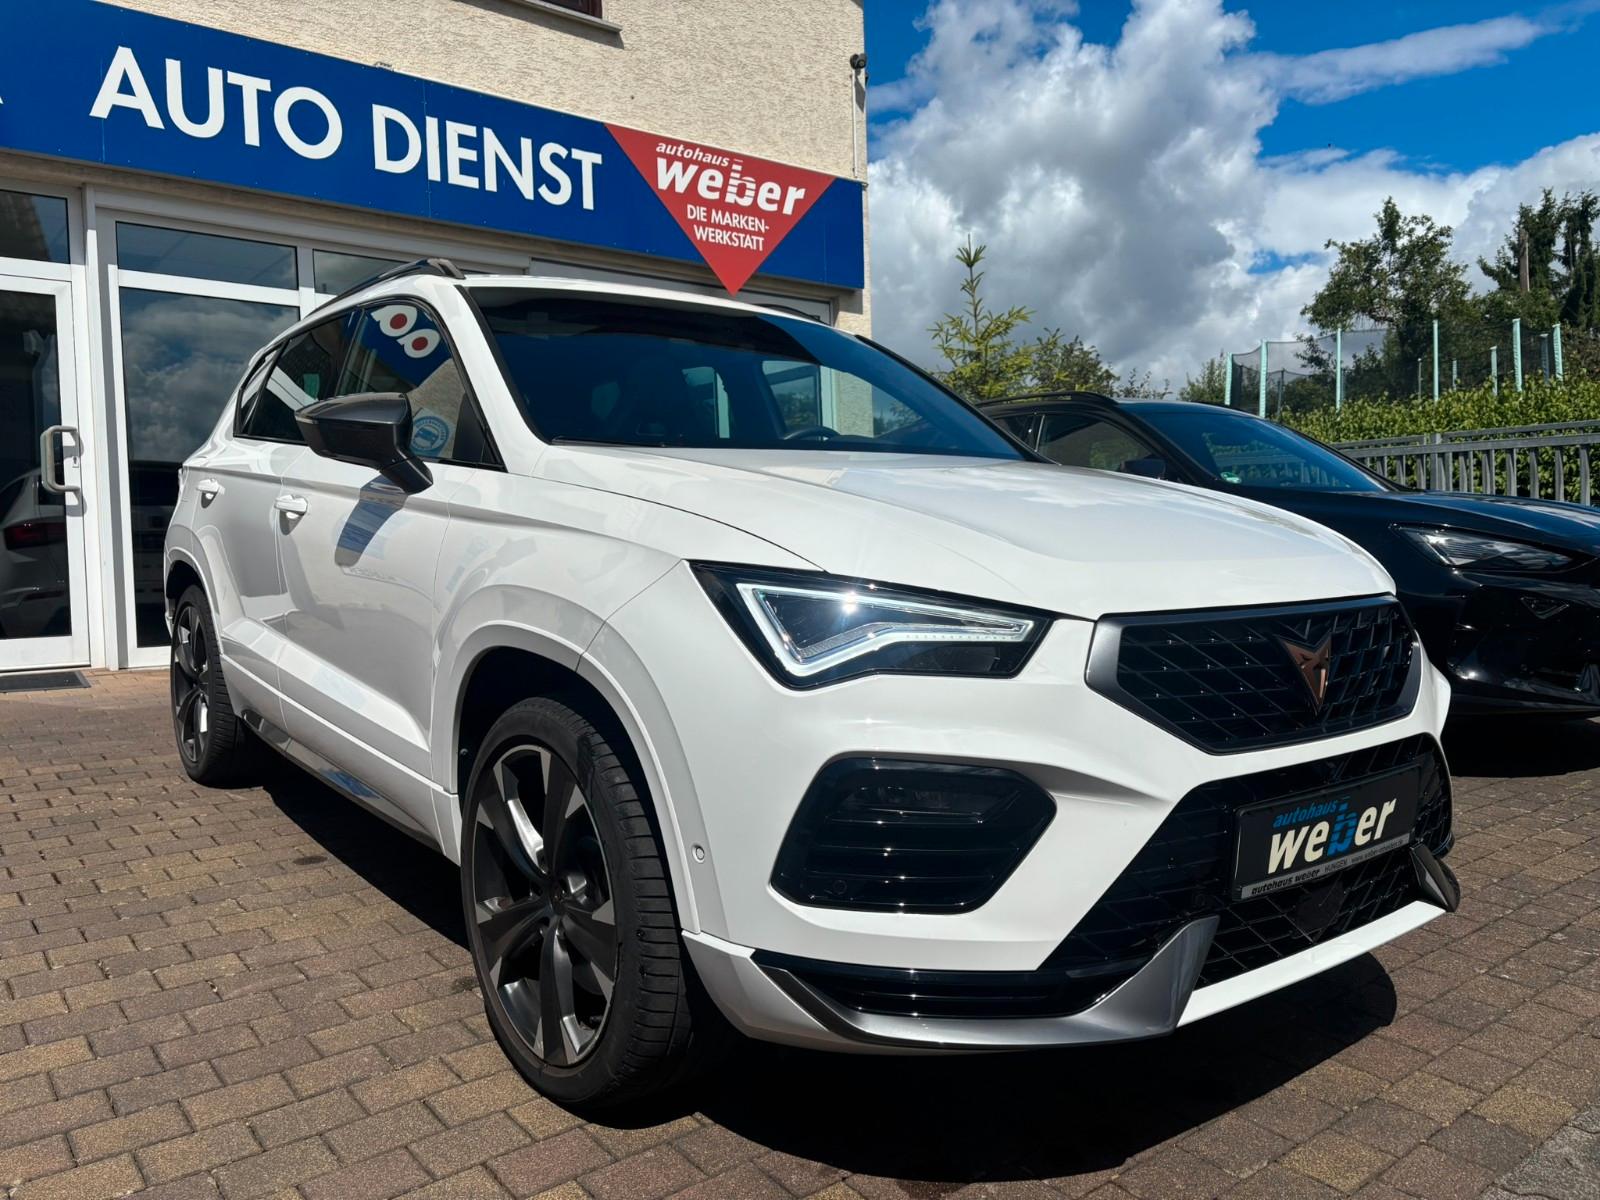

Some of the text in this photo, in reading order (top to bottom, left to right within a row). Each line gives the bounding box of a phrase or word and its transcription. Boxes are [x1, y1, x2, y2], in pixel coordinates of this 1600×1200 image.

[90, 46, 602, 210] AUTO DIENST
[656, 142, 729, 167] autohaus
[656, 158, 806, 216] weber
[687, 204, 770, 233] DIE MARKEN-
[693, 225, 764, 251] WERKSTATT
[1273, 799, 1338, 828] autohaus
[1267, 795, 1397, 874] weber
[1252, 877, 1293, 895] autohaus
